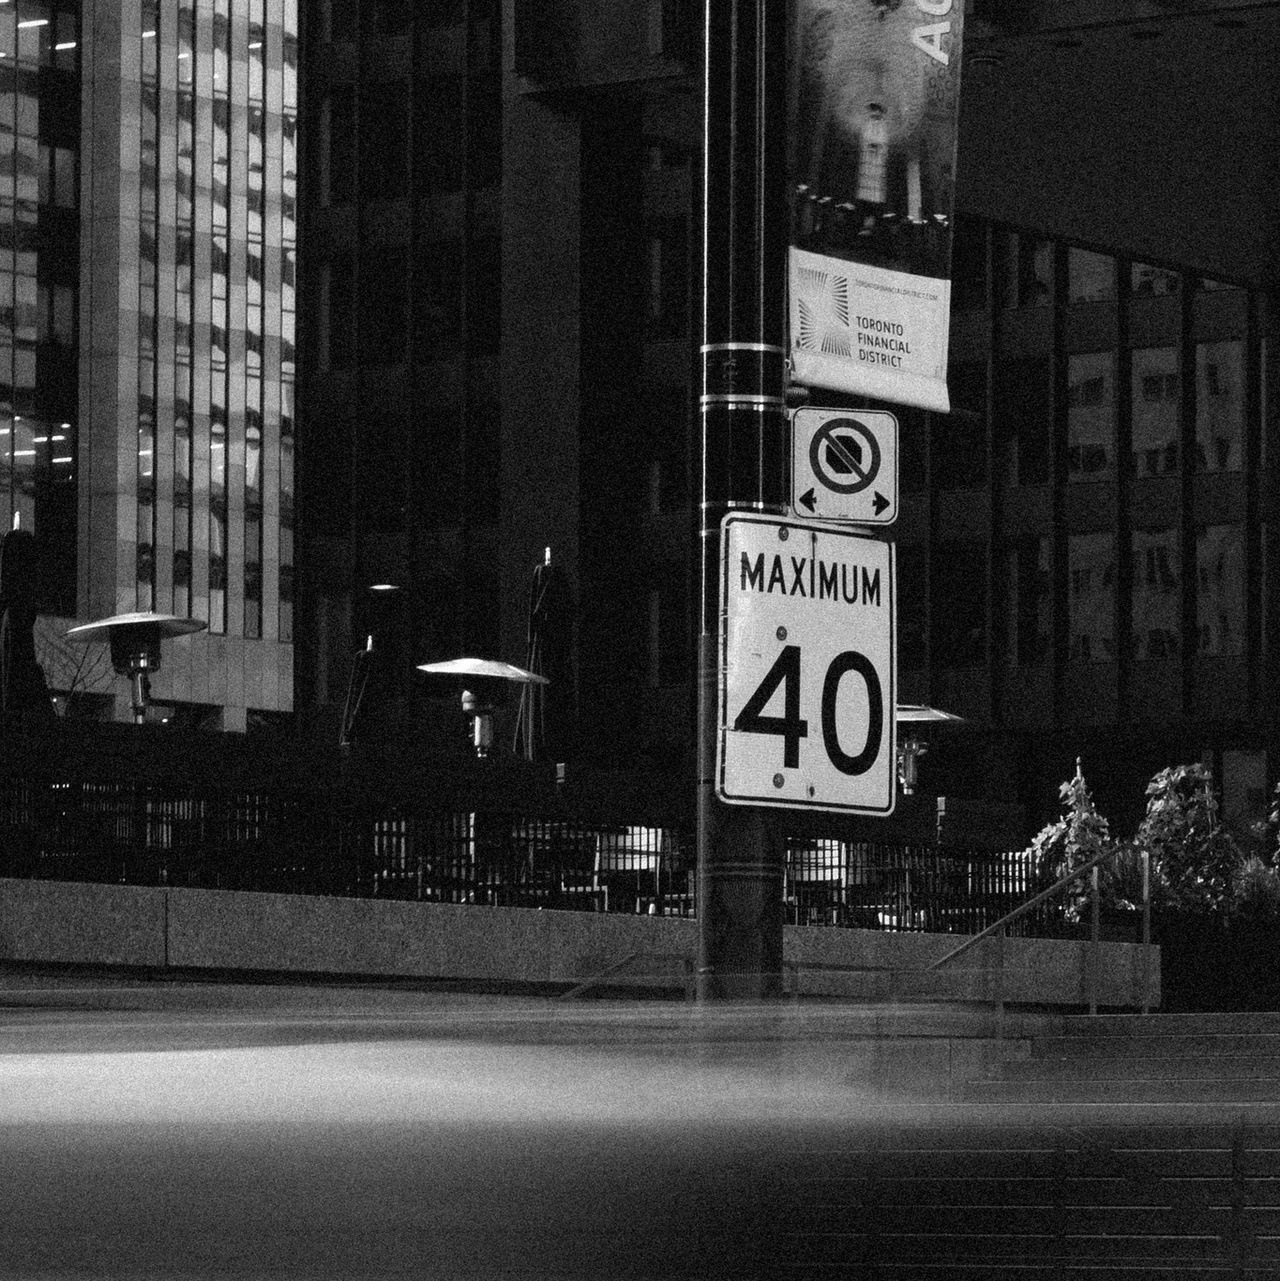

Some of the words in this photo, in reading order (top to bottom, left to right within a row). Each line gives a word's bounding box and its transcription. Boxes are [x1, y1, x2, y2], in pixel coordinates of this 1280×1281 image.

[856, 315, 904, 337] TORONTO
[857, 332, 911, 354] FINANCIAL
[859, 348, 902, 368] DISTRICT
[740, 551, 882, 607] MAXIMUM
[733, 645, 884, 776] 40
